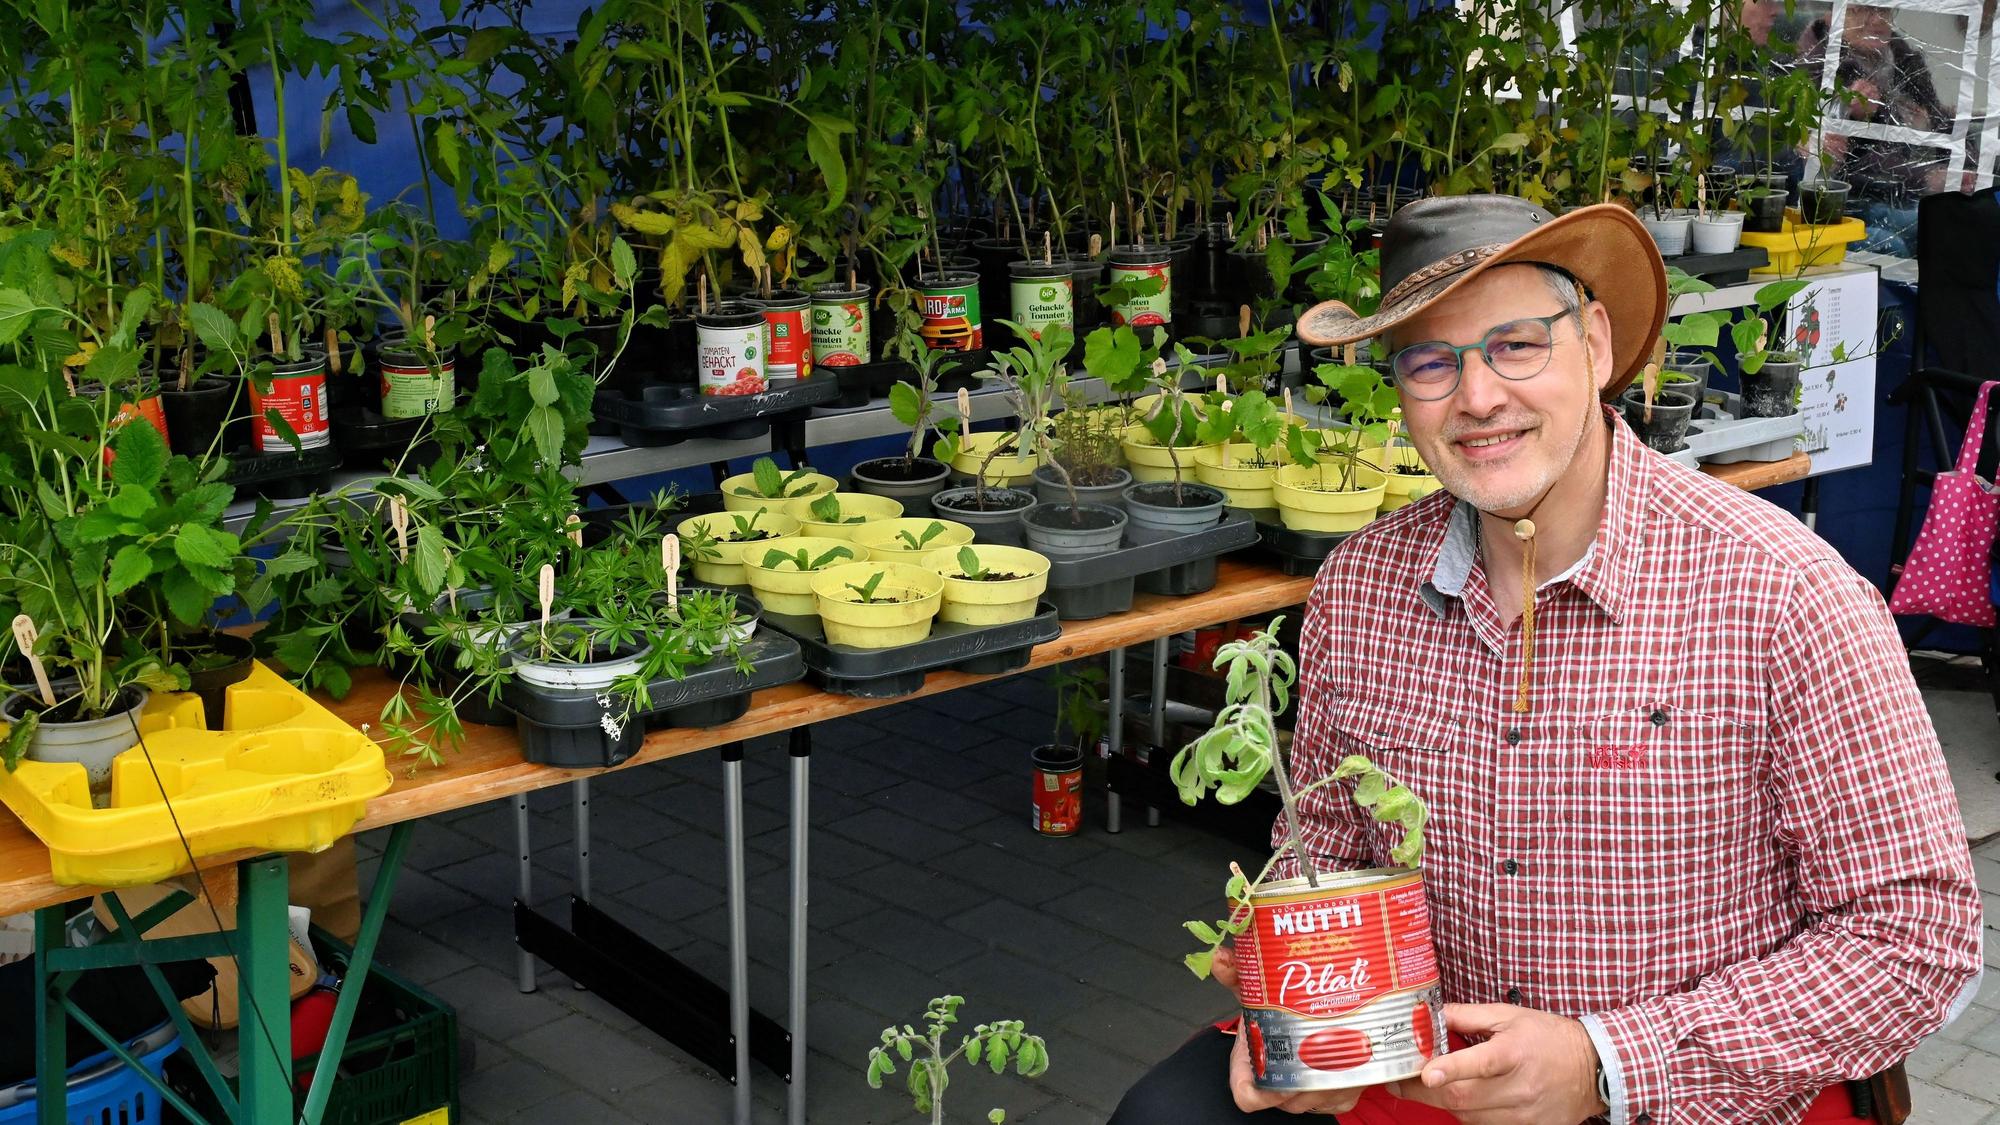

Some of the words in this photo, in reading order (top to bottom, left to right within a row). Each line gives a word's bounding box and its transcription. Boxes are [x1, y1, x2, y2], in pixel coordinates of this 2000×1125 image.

[1029, 304, 1065, 312] Gehackte
[816, 311, 827, 320] bio
[1031, 312, 1065, 321] Tomaten
[813, 328, 842, 336] hackte
[703, 346, 730, 356] TOMATEN
[702, 355, 736, 369] GEHACKT
[1593, 744, 1618, 757] Jack
[1272, 906, 1295, 915] SOLO
[1302, 898, 1359, 911] POMODORO
[1272, 904, 1363, 936] MUTTI
[1277, 957, 1372, 1005] Pelati
[1309, 993, 1361, 1013] gastronomia
